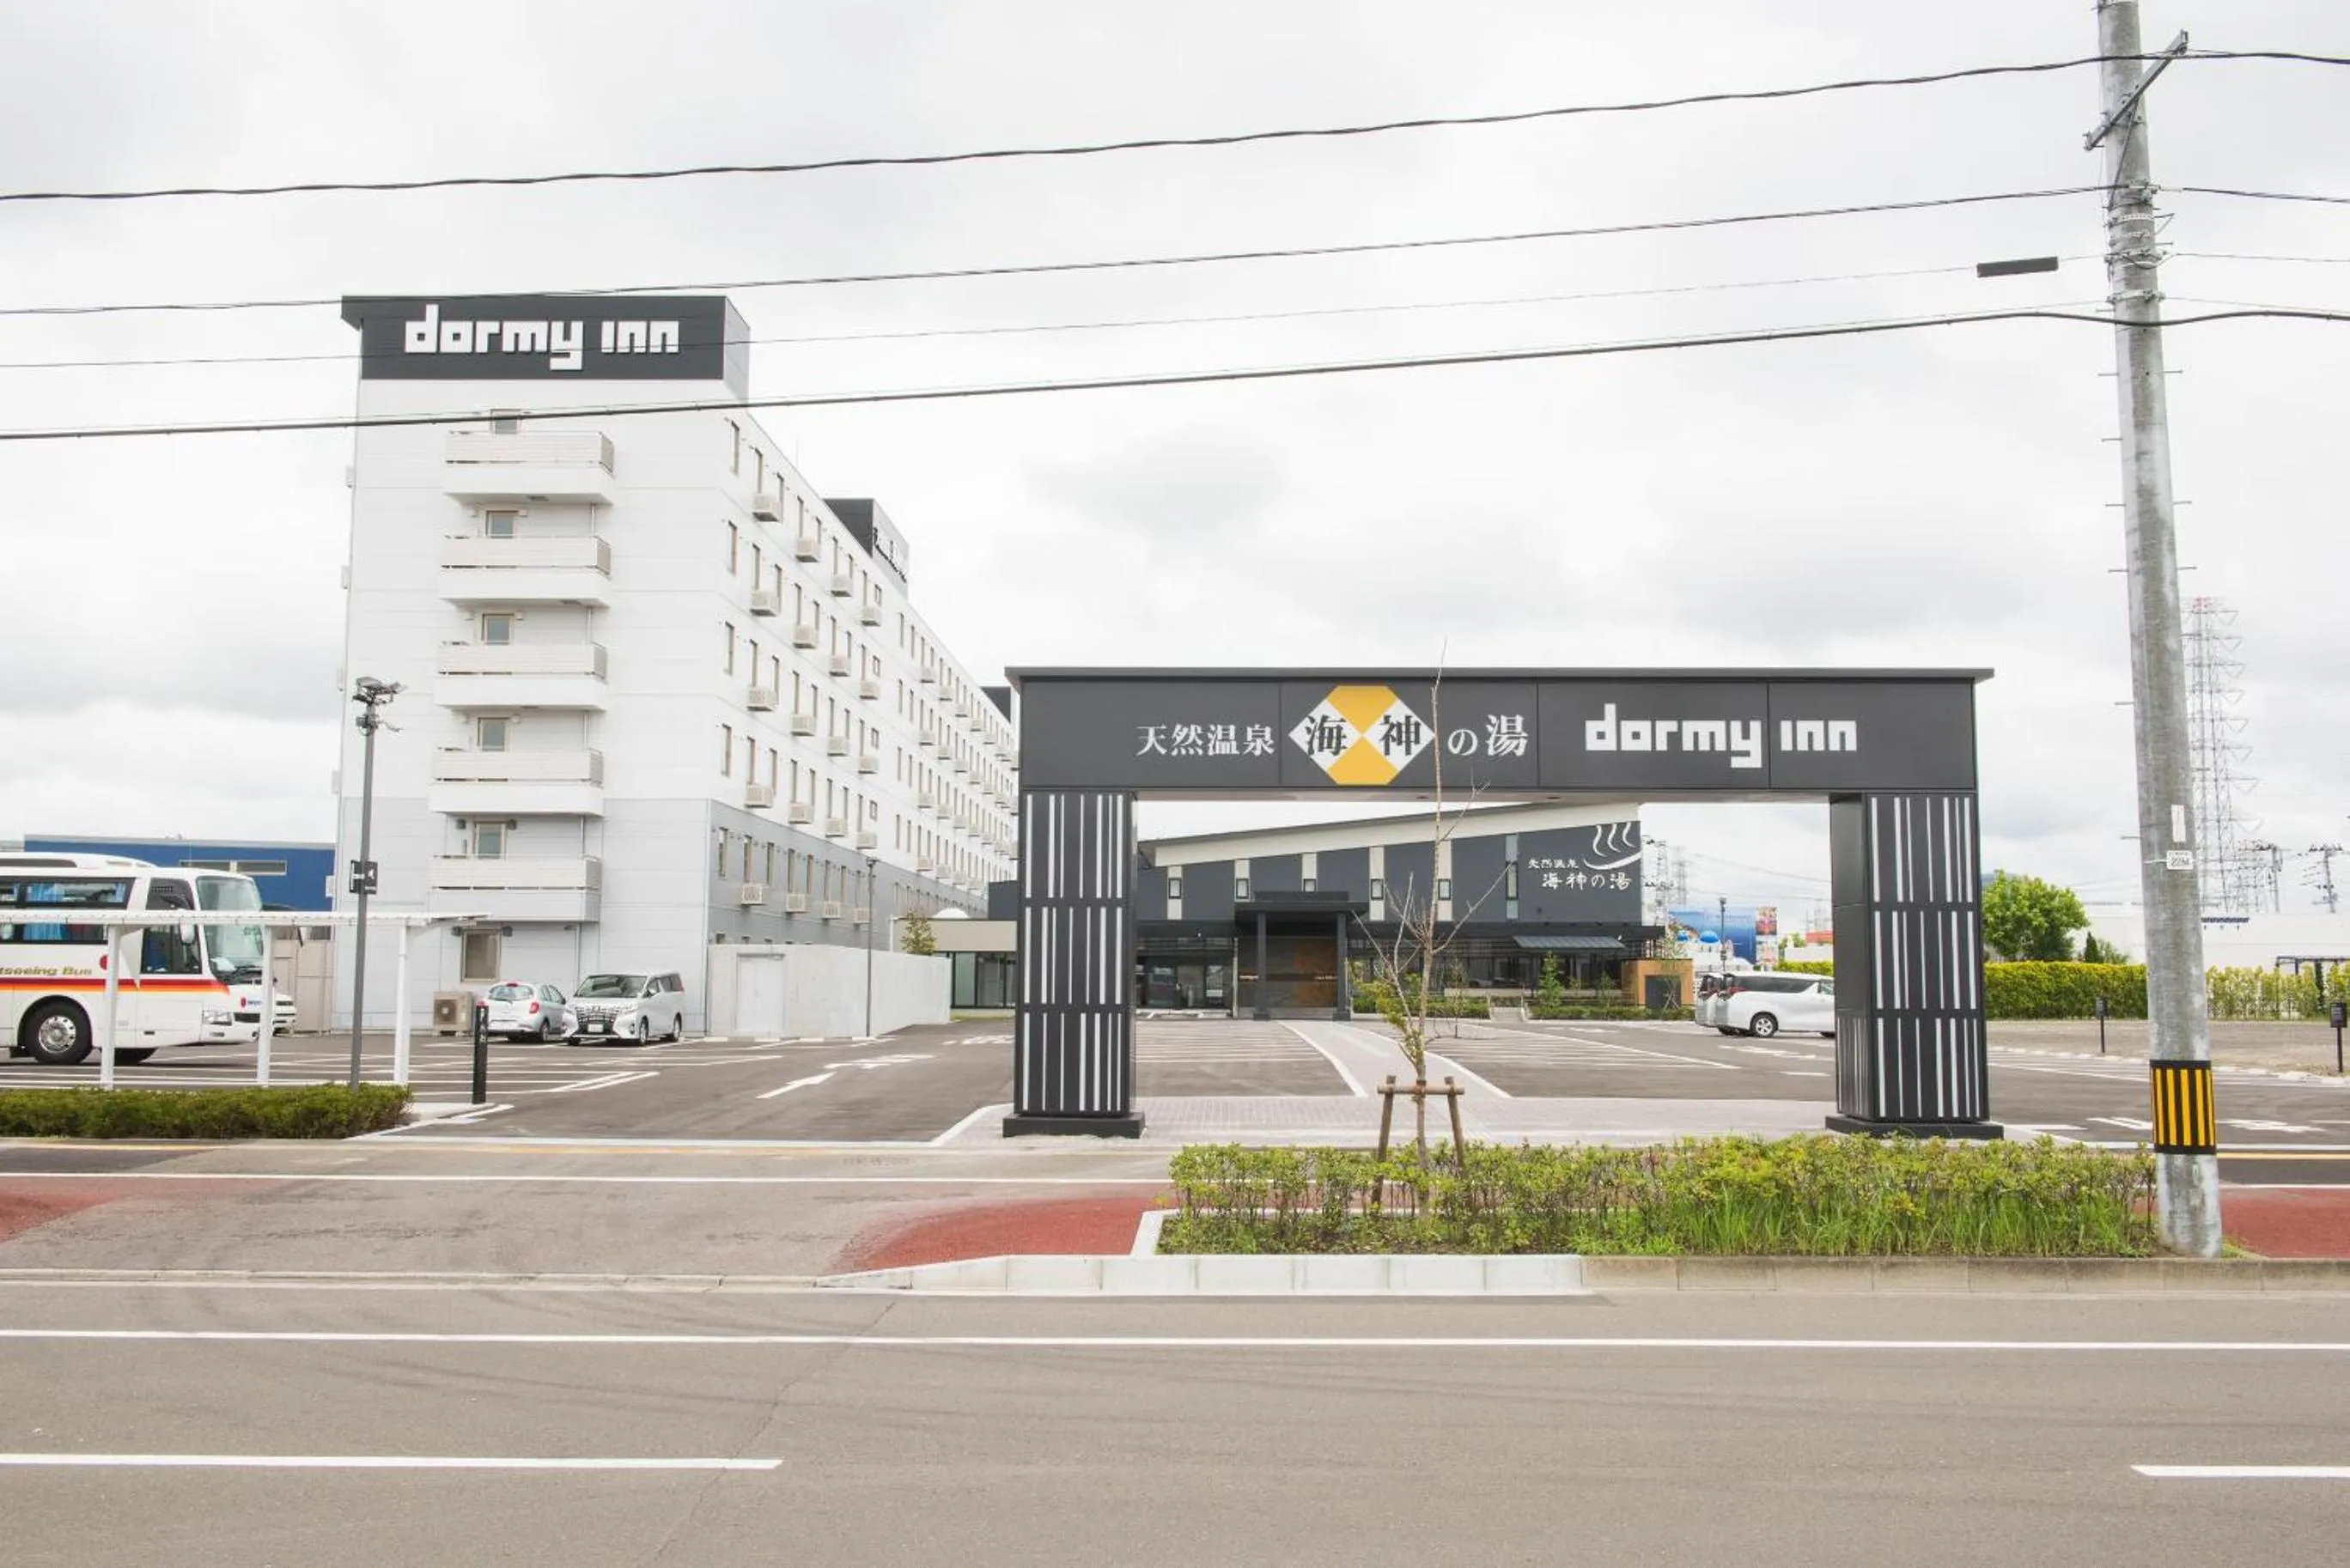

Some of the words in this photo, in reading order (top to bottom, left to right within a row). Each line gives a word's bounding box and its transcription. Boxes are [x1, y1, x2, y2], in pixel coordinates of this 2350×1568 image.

[405, 303, 584, 372] dormy
[600, 320, 679, 354] inn
[1135, 724, 1275, 757] 天然温泉
[1305, 714, 1530, 757] 海神の湯
[1585, 702, 1762, 769] dormy
[1780, 720, 1858, 751] inn
[1542, 872, 1631, 890] 海神の湯
